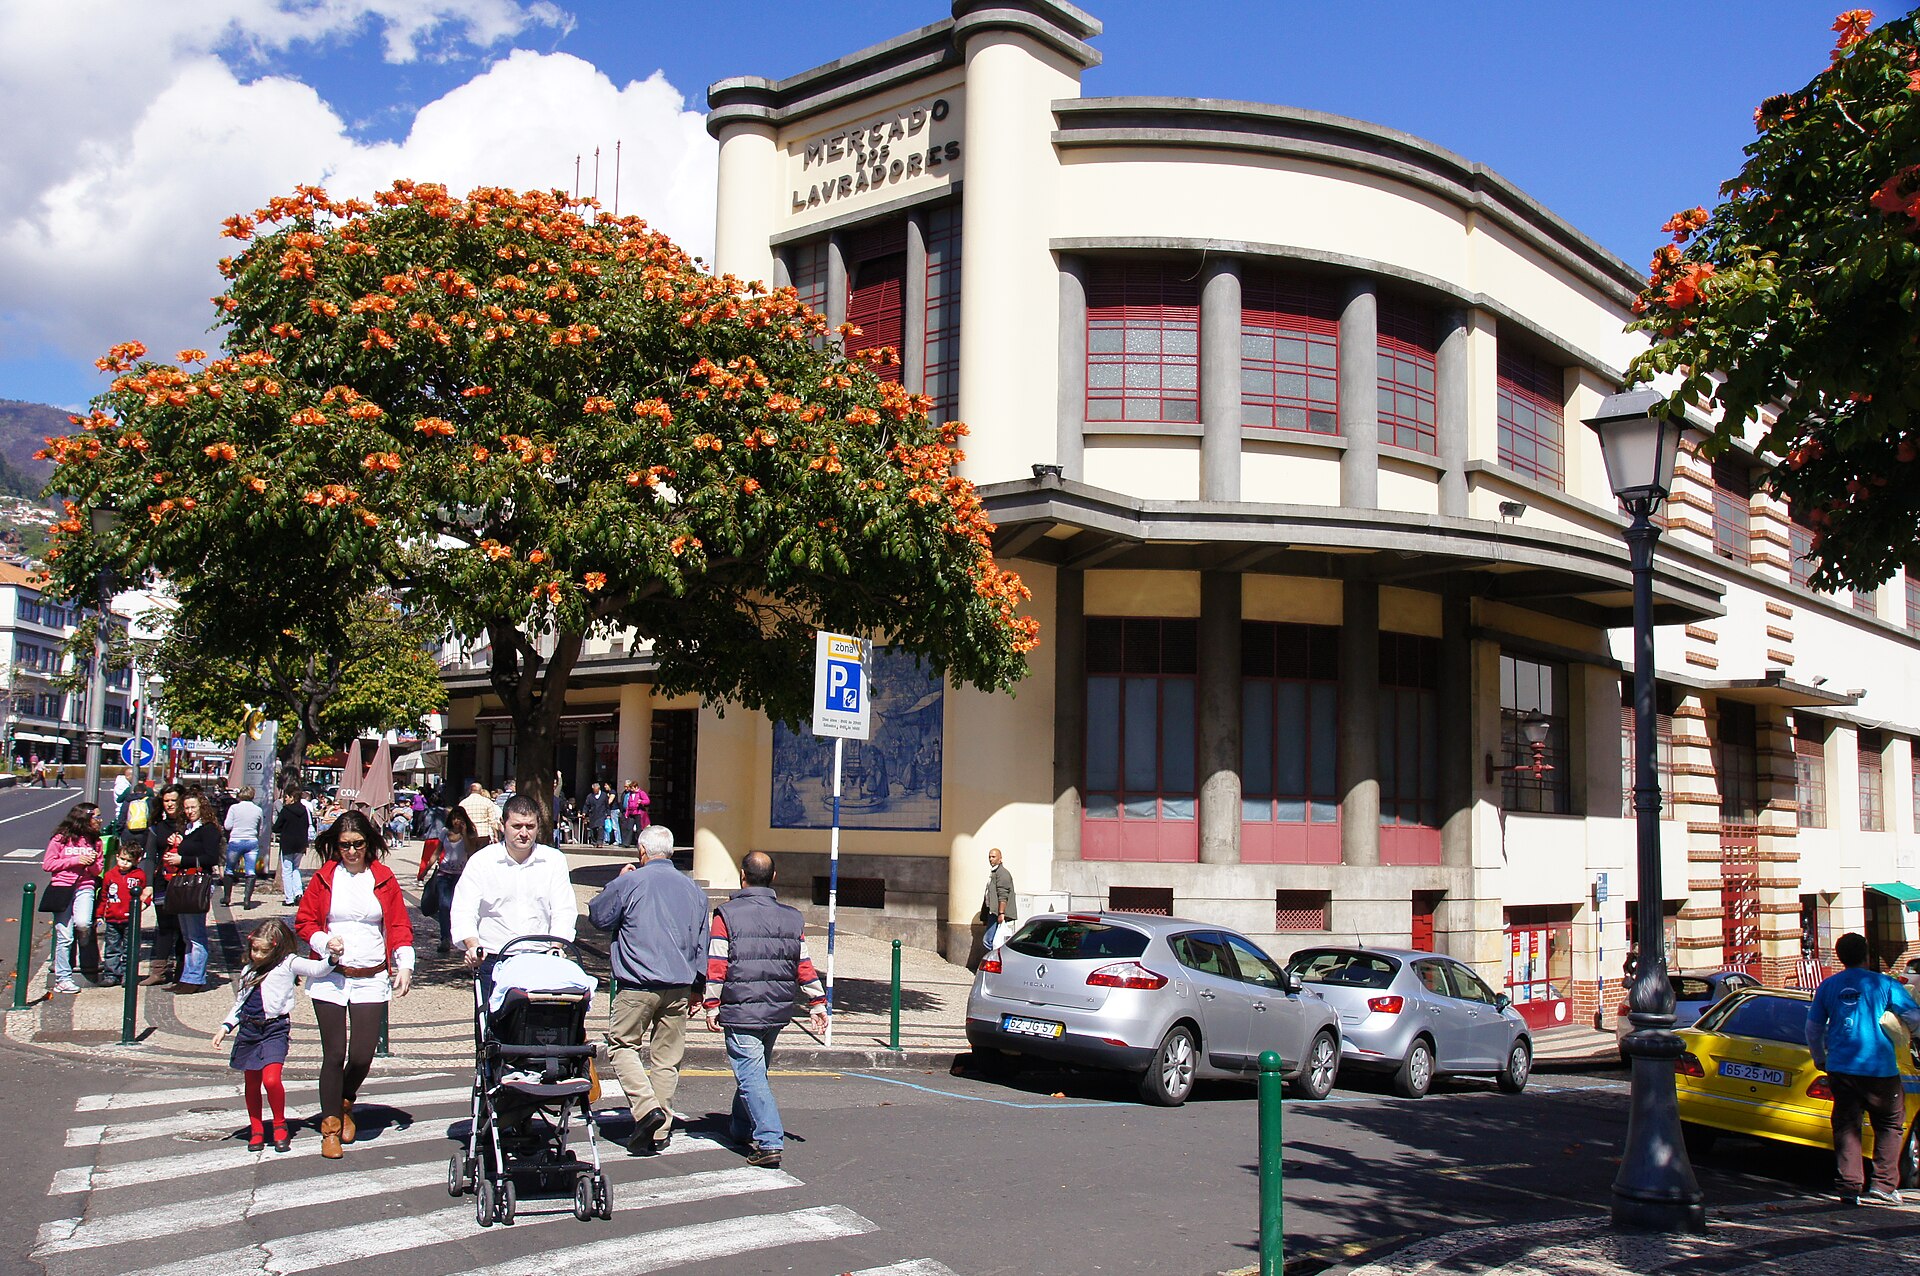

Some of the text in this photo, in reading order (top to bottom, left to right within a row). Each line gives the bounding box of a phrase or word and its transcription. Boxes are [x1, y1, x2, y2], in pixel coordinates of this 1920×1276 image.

[803, 99, 949, 171] MERCADO
[856, 144, 890, 172] DOS
[792, 140, 961, 215] LAVRADORES
[835, 643, 854, 654] zona
[829, 664, 848, 698] P
